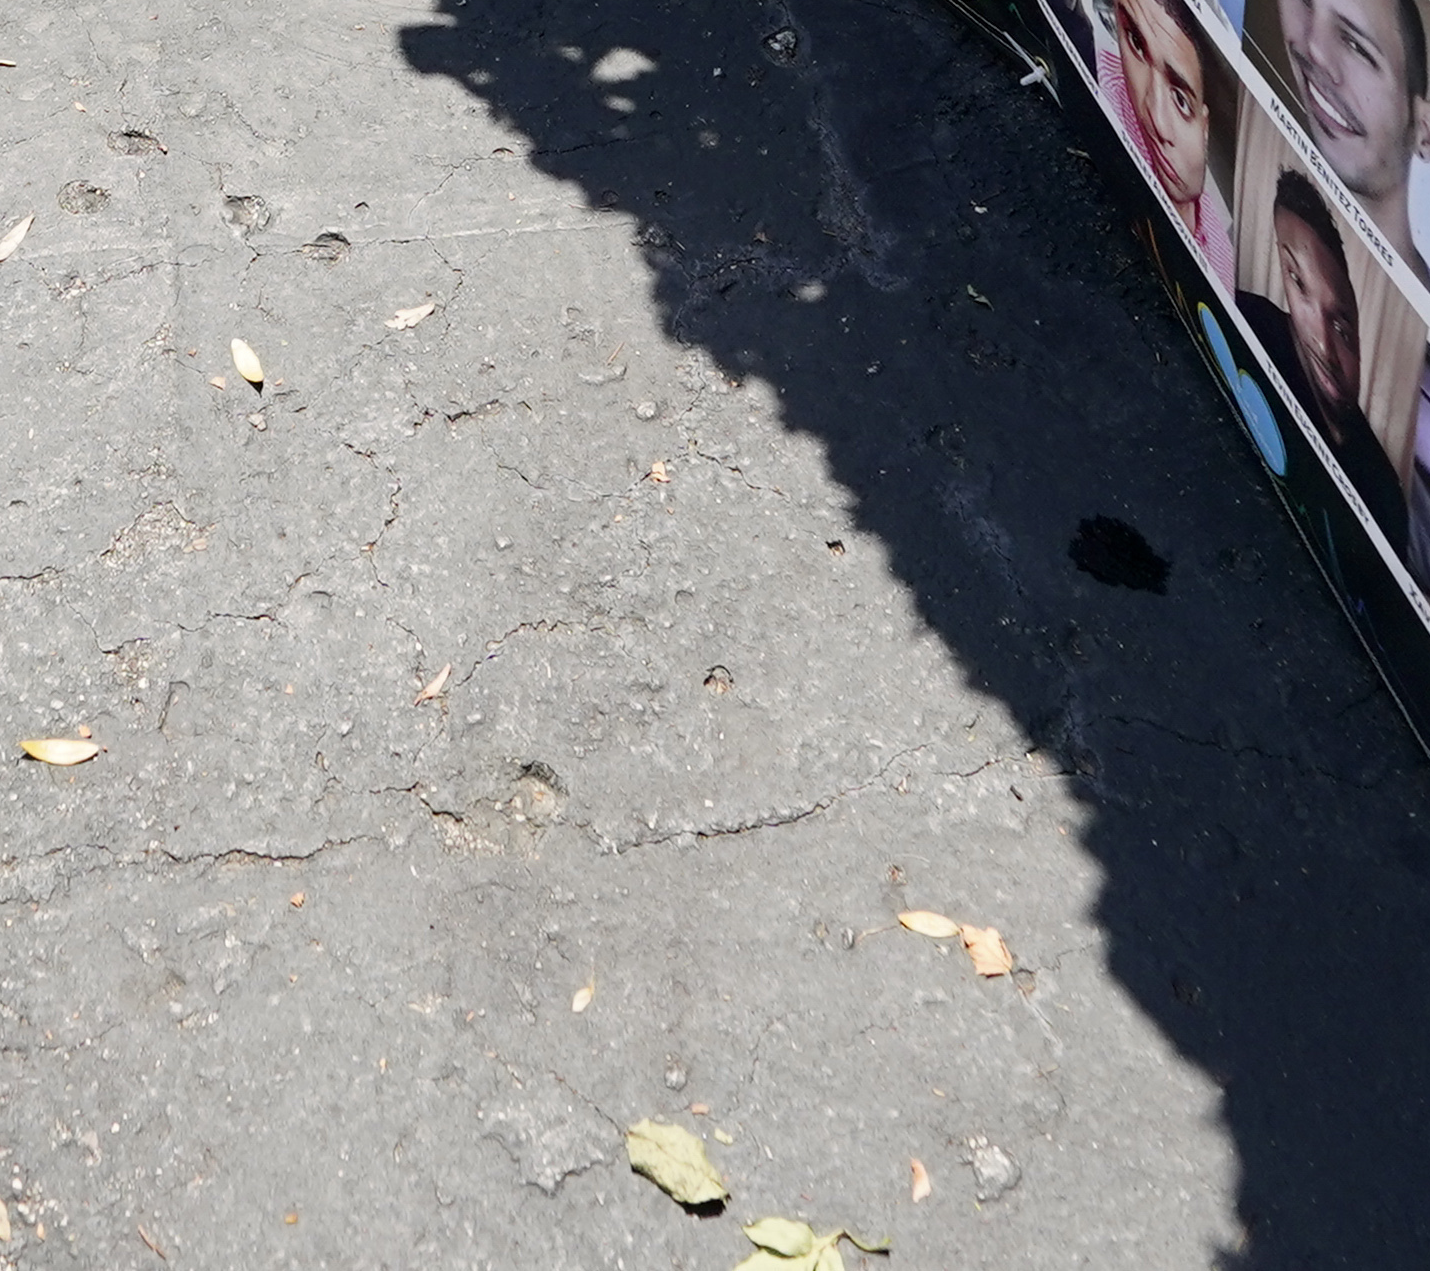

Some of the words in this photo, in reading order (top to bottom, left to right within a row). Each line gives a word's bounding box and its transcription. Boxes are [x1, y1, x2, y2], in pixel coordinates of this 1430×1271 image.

[1269, 97, 1308, 157] MARTIN
[1309, 149, 1353, 214] BENITEZ
[1353, 207, 1395, 268] TORRES
